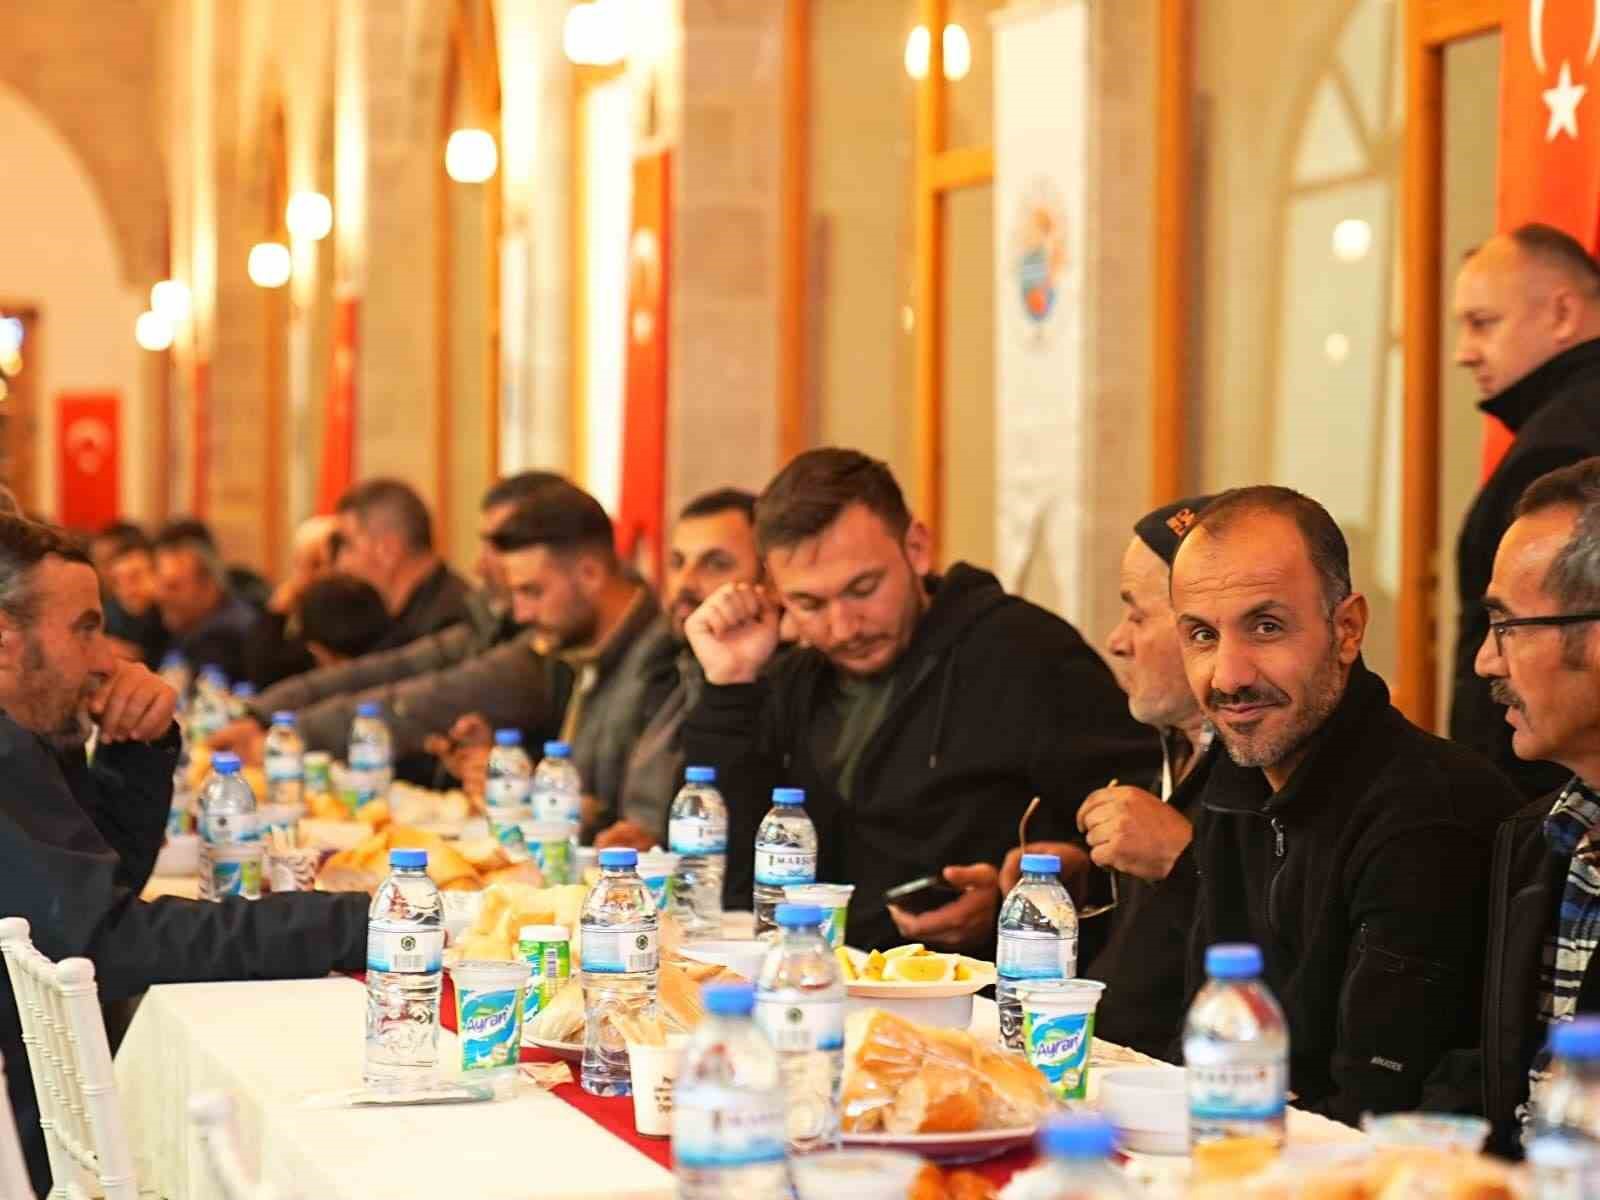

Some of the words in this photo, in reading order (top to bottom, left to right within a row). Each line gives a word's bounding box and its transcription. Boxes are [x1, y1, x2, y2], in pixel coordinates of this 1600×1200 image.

[776, 855, 816, 866] MARS
[467, 1008, 508, 1033] Ayran
[1036, 1036, 1079, 1056] Ayran
